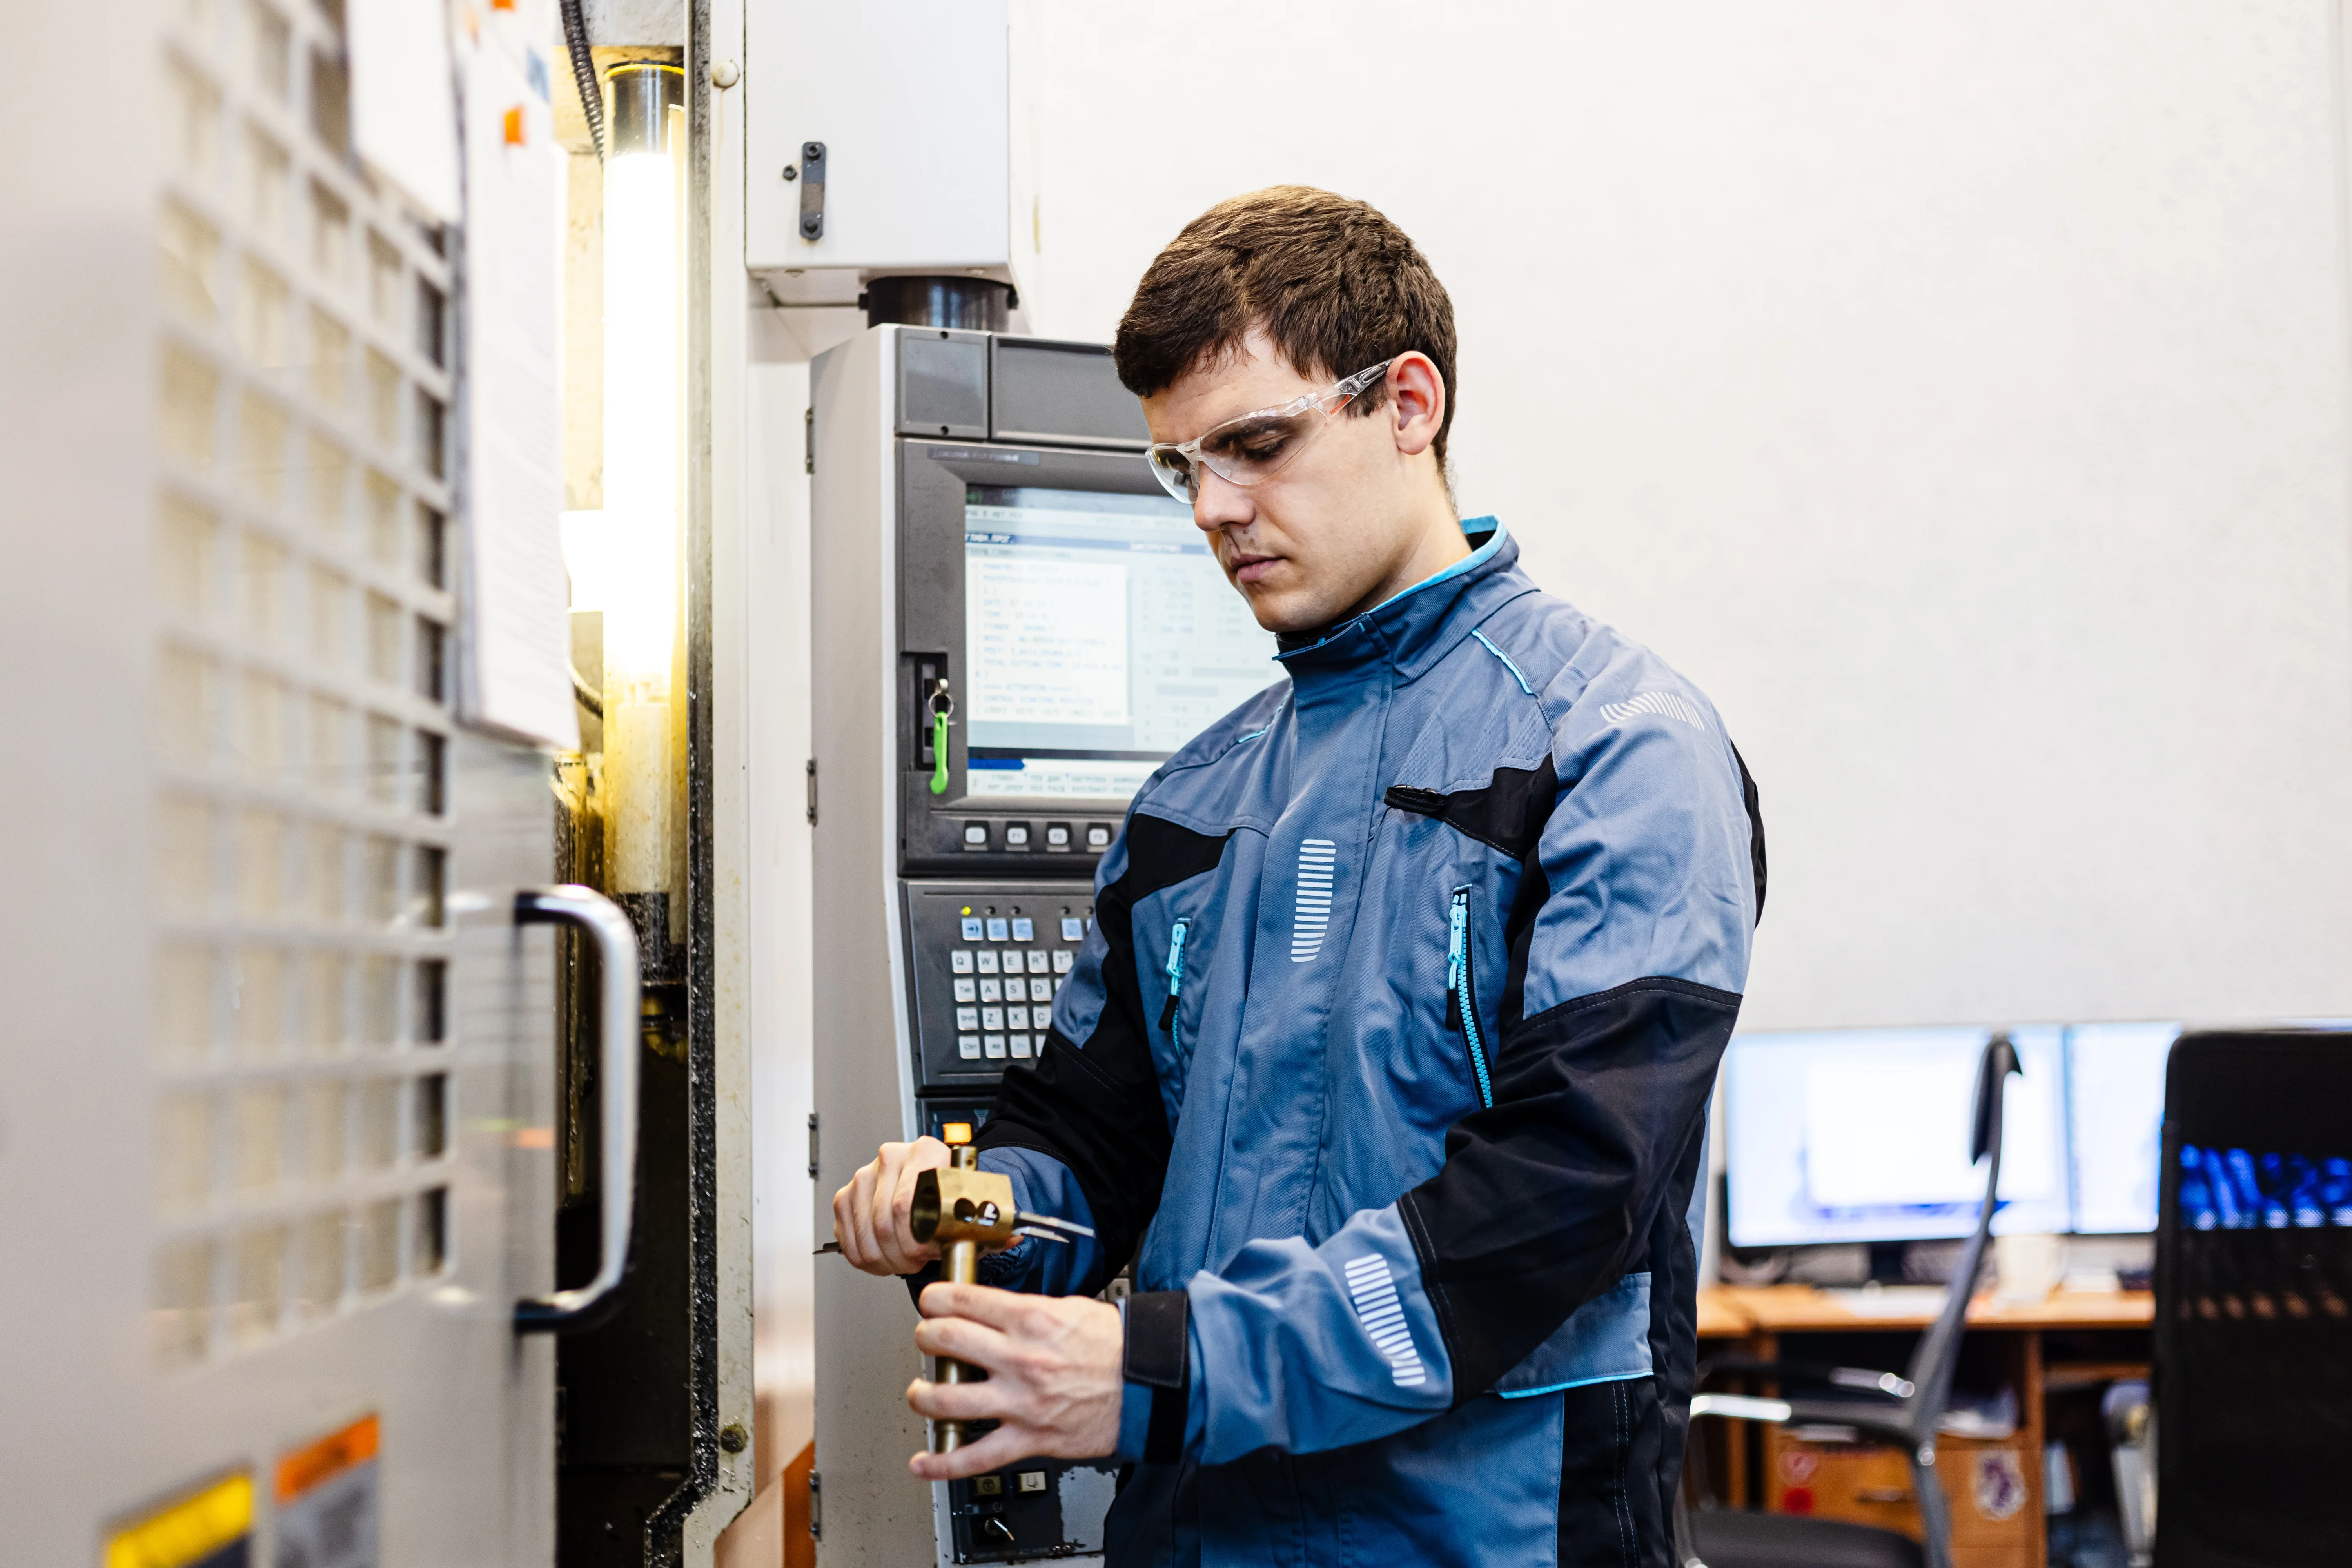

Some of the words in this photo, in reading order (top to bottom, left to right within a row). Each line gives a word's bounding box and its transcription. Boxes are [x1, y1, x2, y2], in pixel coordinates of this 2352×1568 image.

[956, 957, 964, 966] Q
[1007, 956, 1014, 965] E
[1032, 956, 1040, 965] R
[1058, 956, 1063, 965] T
[985, 985, 992, 994] A
[1010, 985, 1017, 994] S
[1035, 985, 1043, 994] D
[987, 1013, 994, 1022] Z
[1013, 1013, 1019, 1022] X
[1037, 1012, 1045, 1022] C
